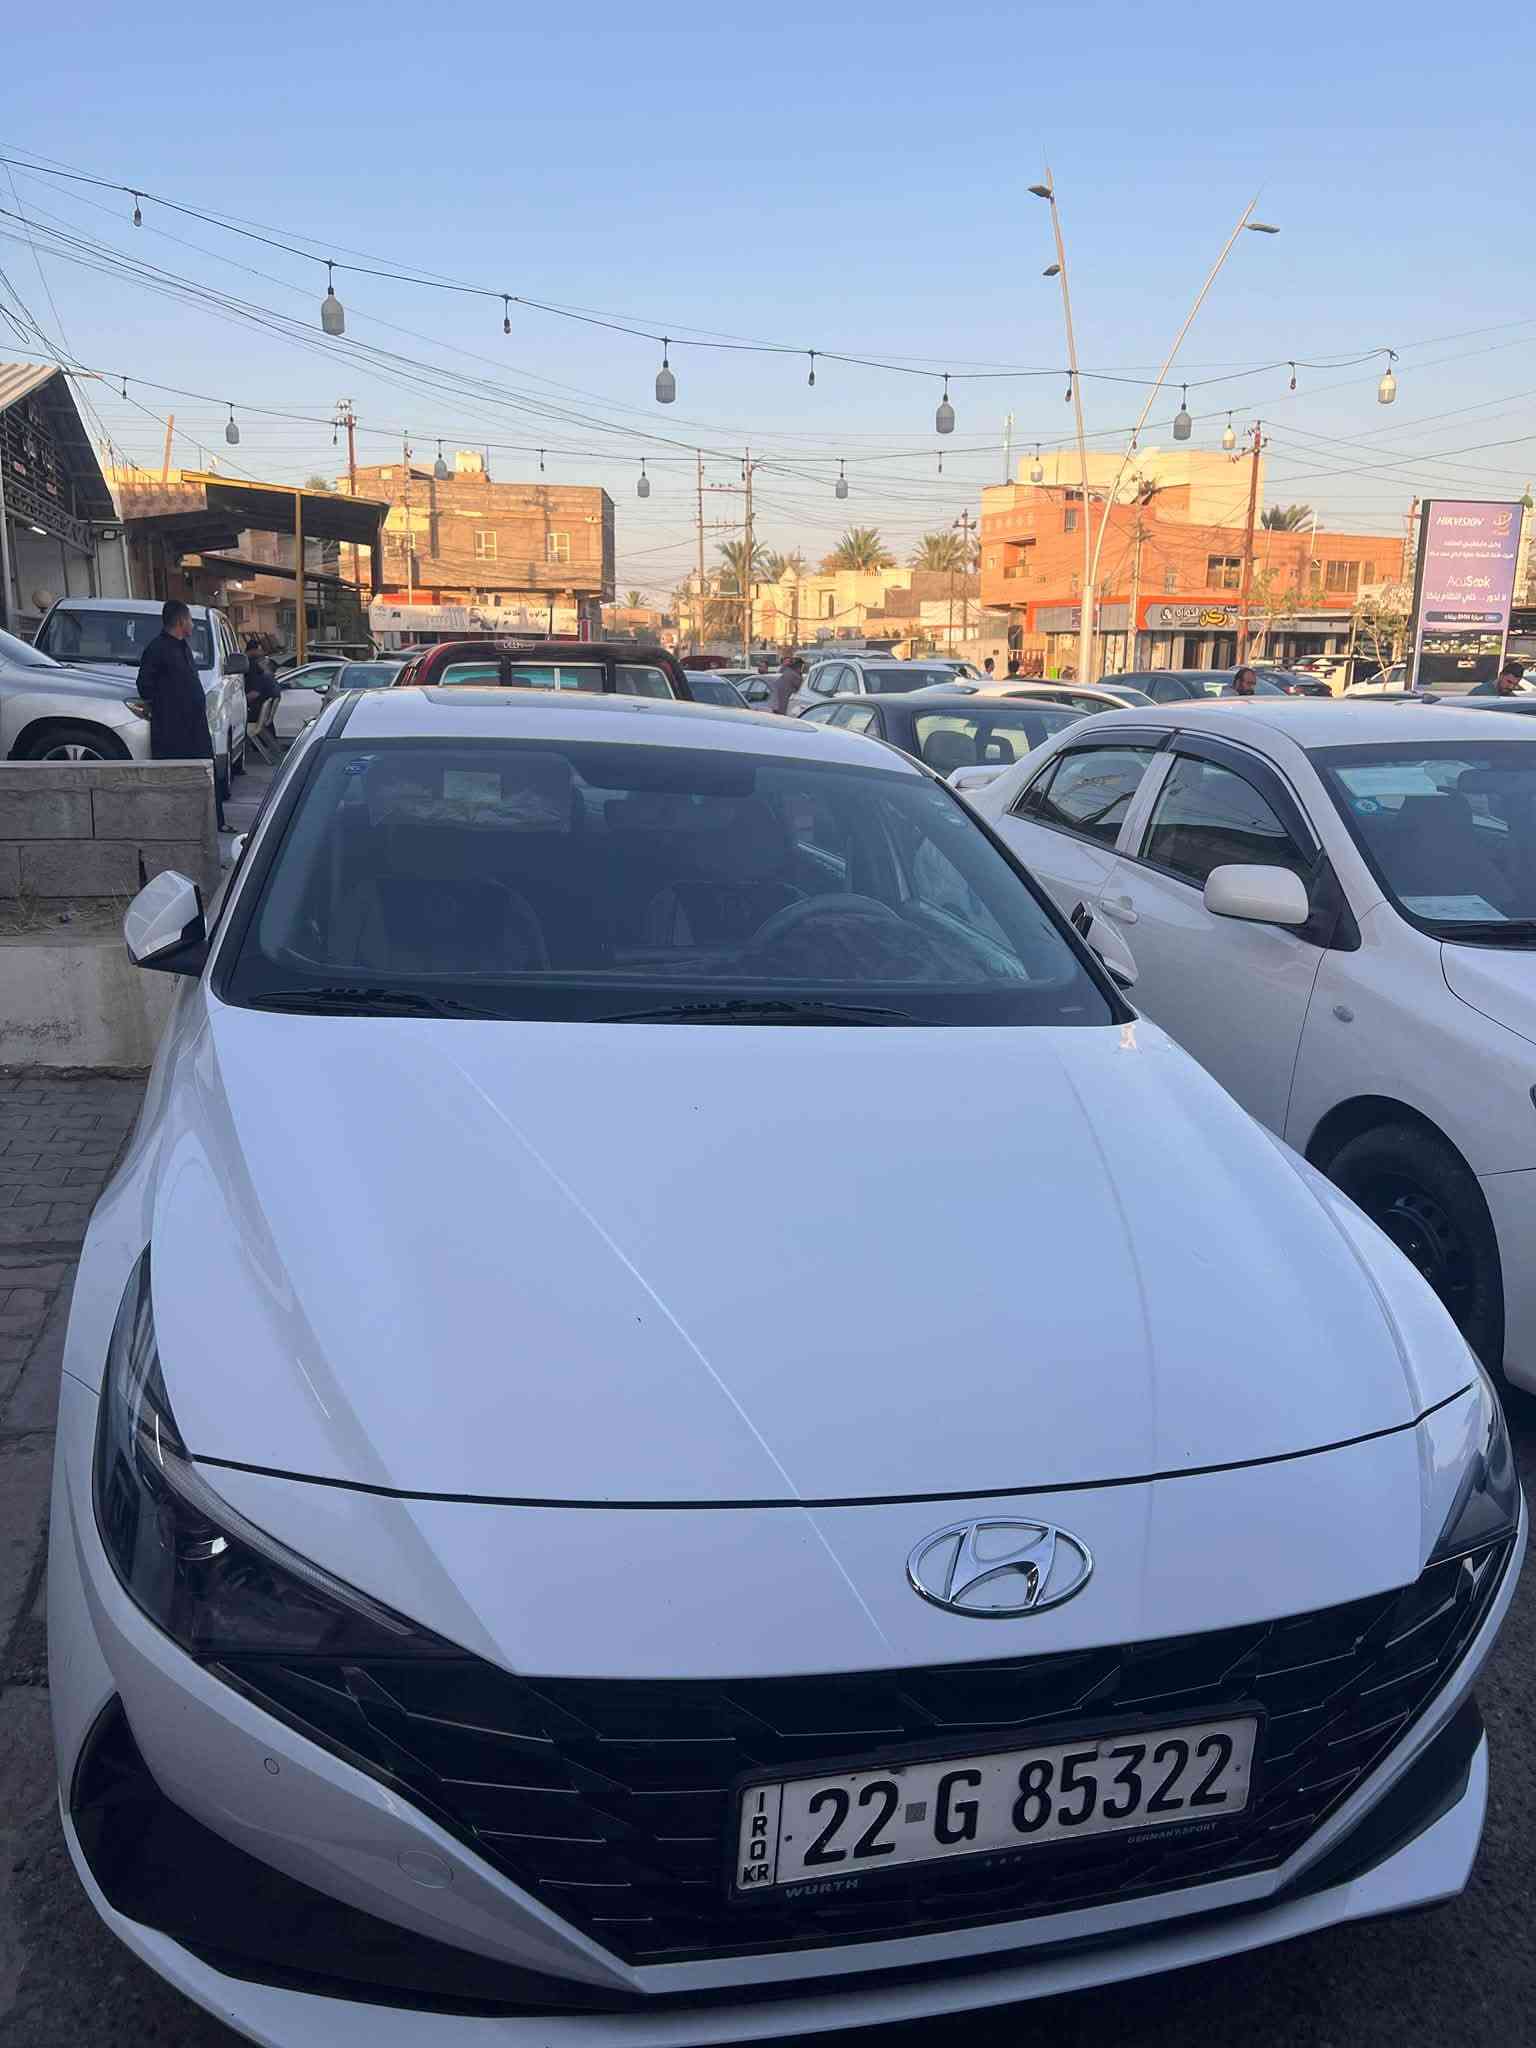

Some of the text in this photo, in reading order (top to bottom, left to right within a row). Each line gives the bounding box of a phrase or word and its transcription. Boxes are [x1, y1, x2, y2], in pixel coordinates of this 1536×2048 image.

[803, 1733, 1234, 1867] 22 G 85322
[742, 1863, 769, 1882] KR
